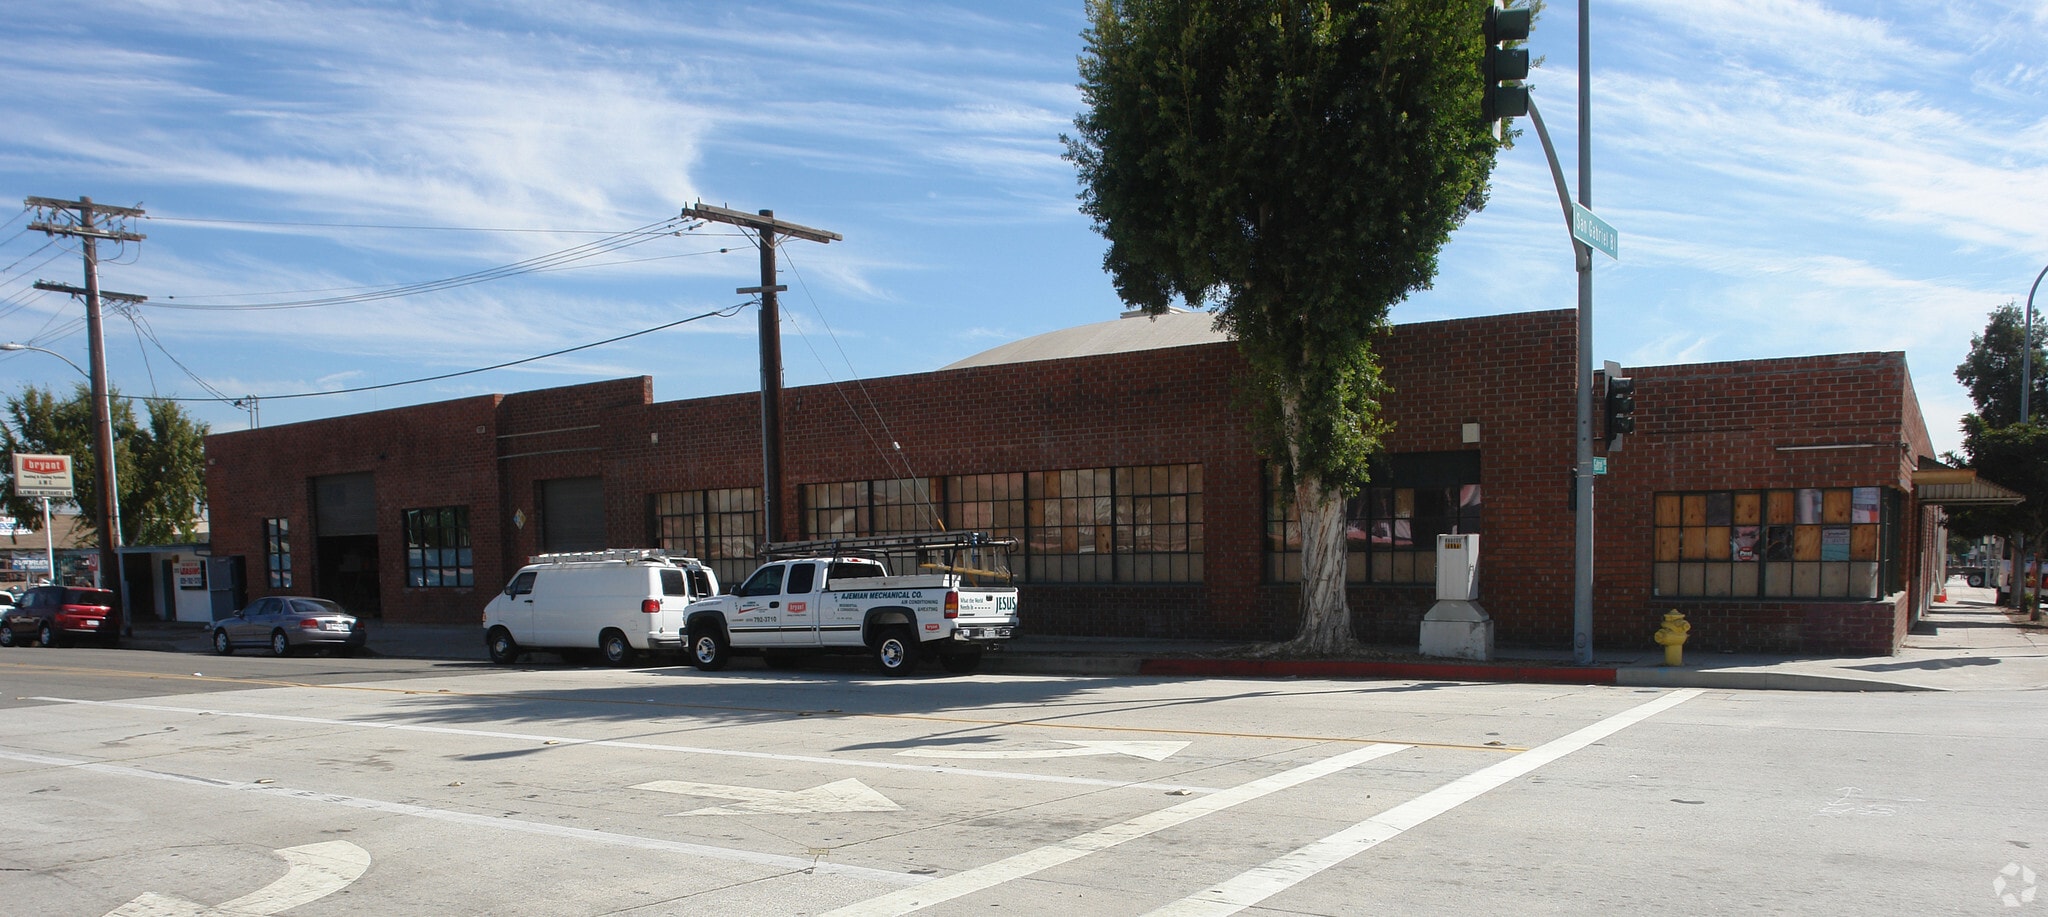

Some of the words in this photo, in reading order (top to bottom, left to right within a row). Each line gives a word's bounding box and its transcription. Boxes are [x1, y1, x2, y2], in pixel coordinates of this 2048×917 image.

[1576, 212, 1588, 234] San
[1589, 220, 1609, 247] Gabriel
[28, 460, 61, 470] bryant
[841, 592, 868, 600] AJEMIAN
[869, 591, 910, 600] MECHANICAL
[996, 596, 1016, 614] JESUS
